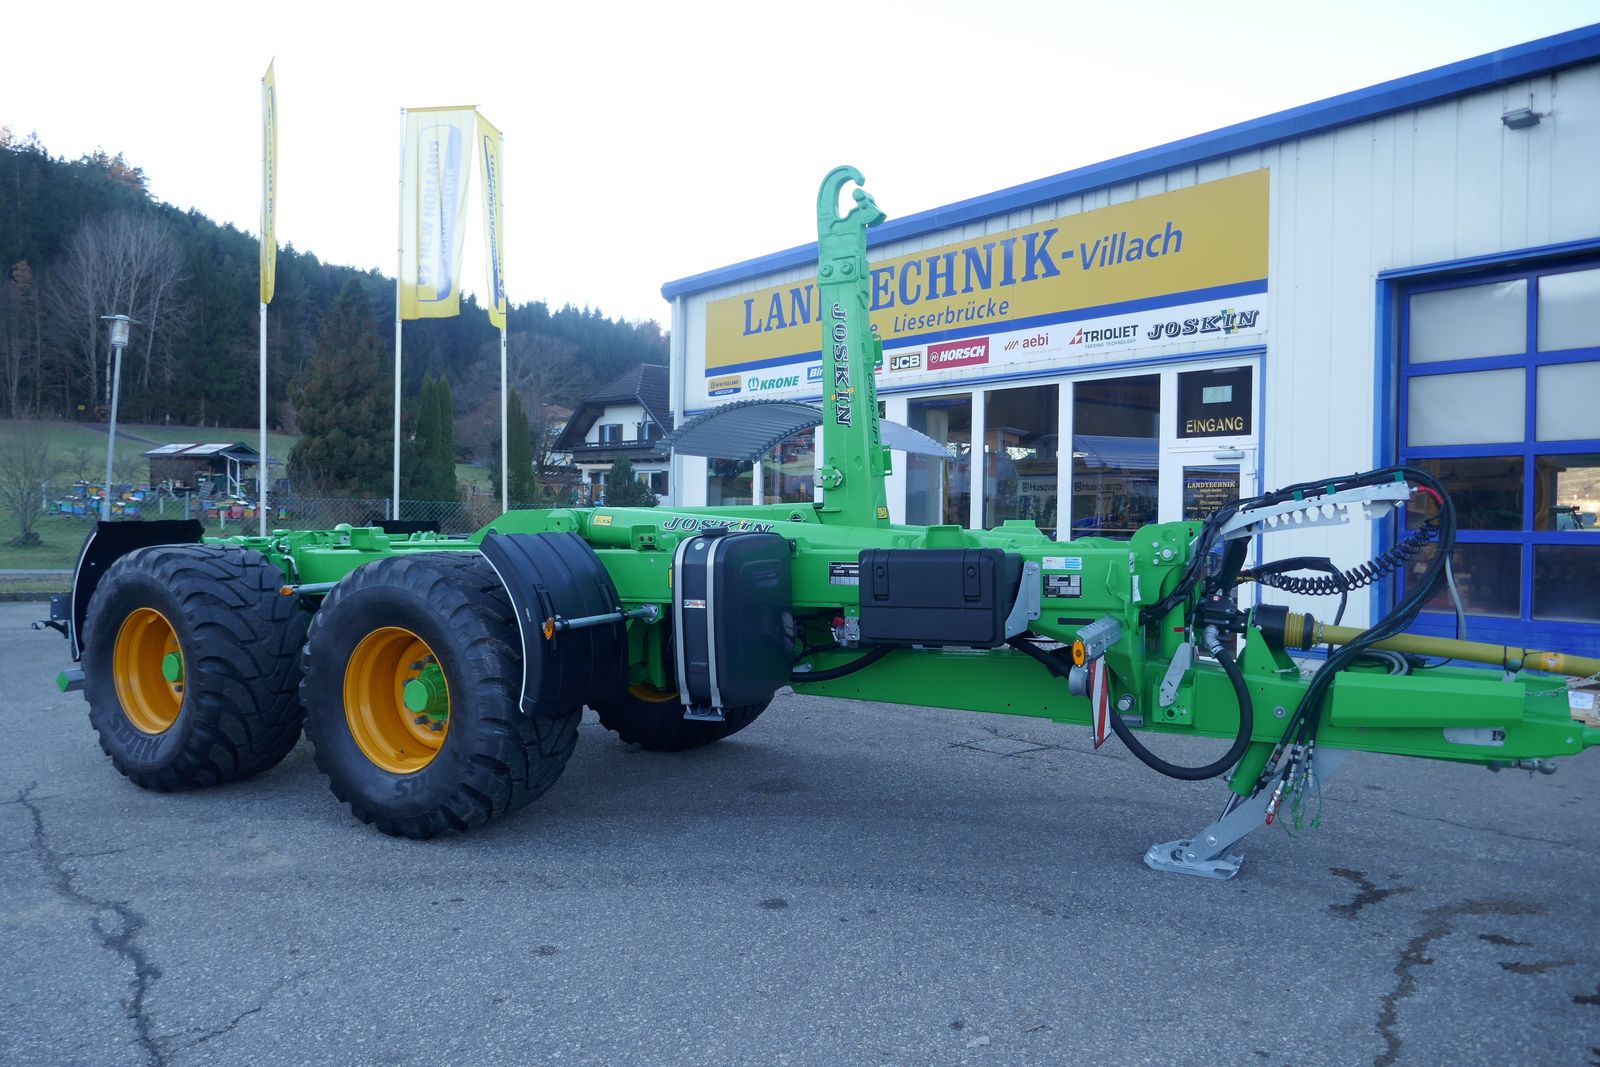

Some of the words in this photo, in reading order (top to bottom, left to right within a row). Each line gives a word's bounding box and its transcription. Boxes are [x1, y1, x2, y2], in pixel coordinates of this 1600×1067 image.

[893, 299, 1010, 334] Lieserbrücke
[1083, 324, 1139, 343] TRIOLIET
[1147, 310, 1260, 341] JOSKIN
[1022, 333, 1049, 349] aebi
[939, 345, 986, 362] HORSCH
[831, 301, 852, 427] JOSKIN
[891, 355, 920, 370] JCB
[760, 375, 800, 390] KRONE
[1186, 416, 1244, 433] EINGANG
